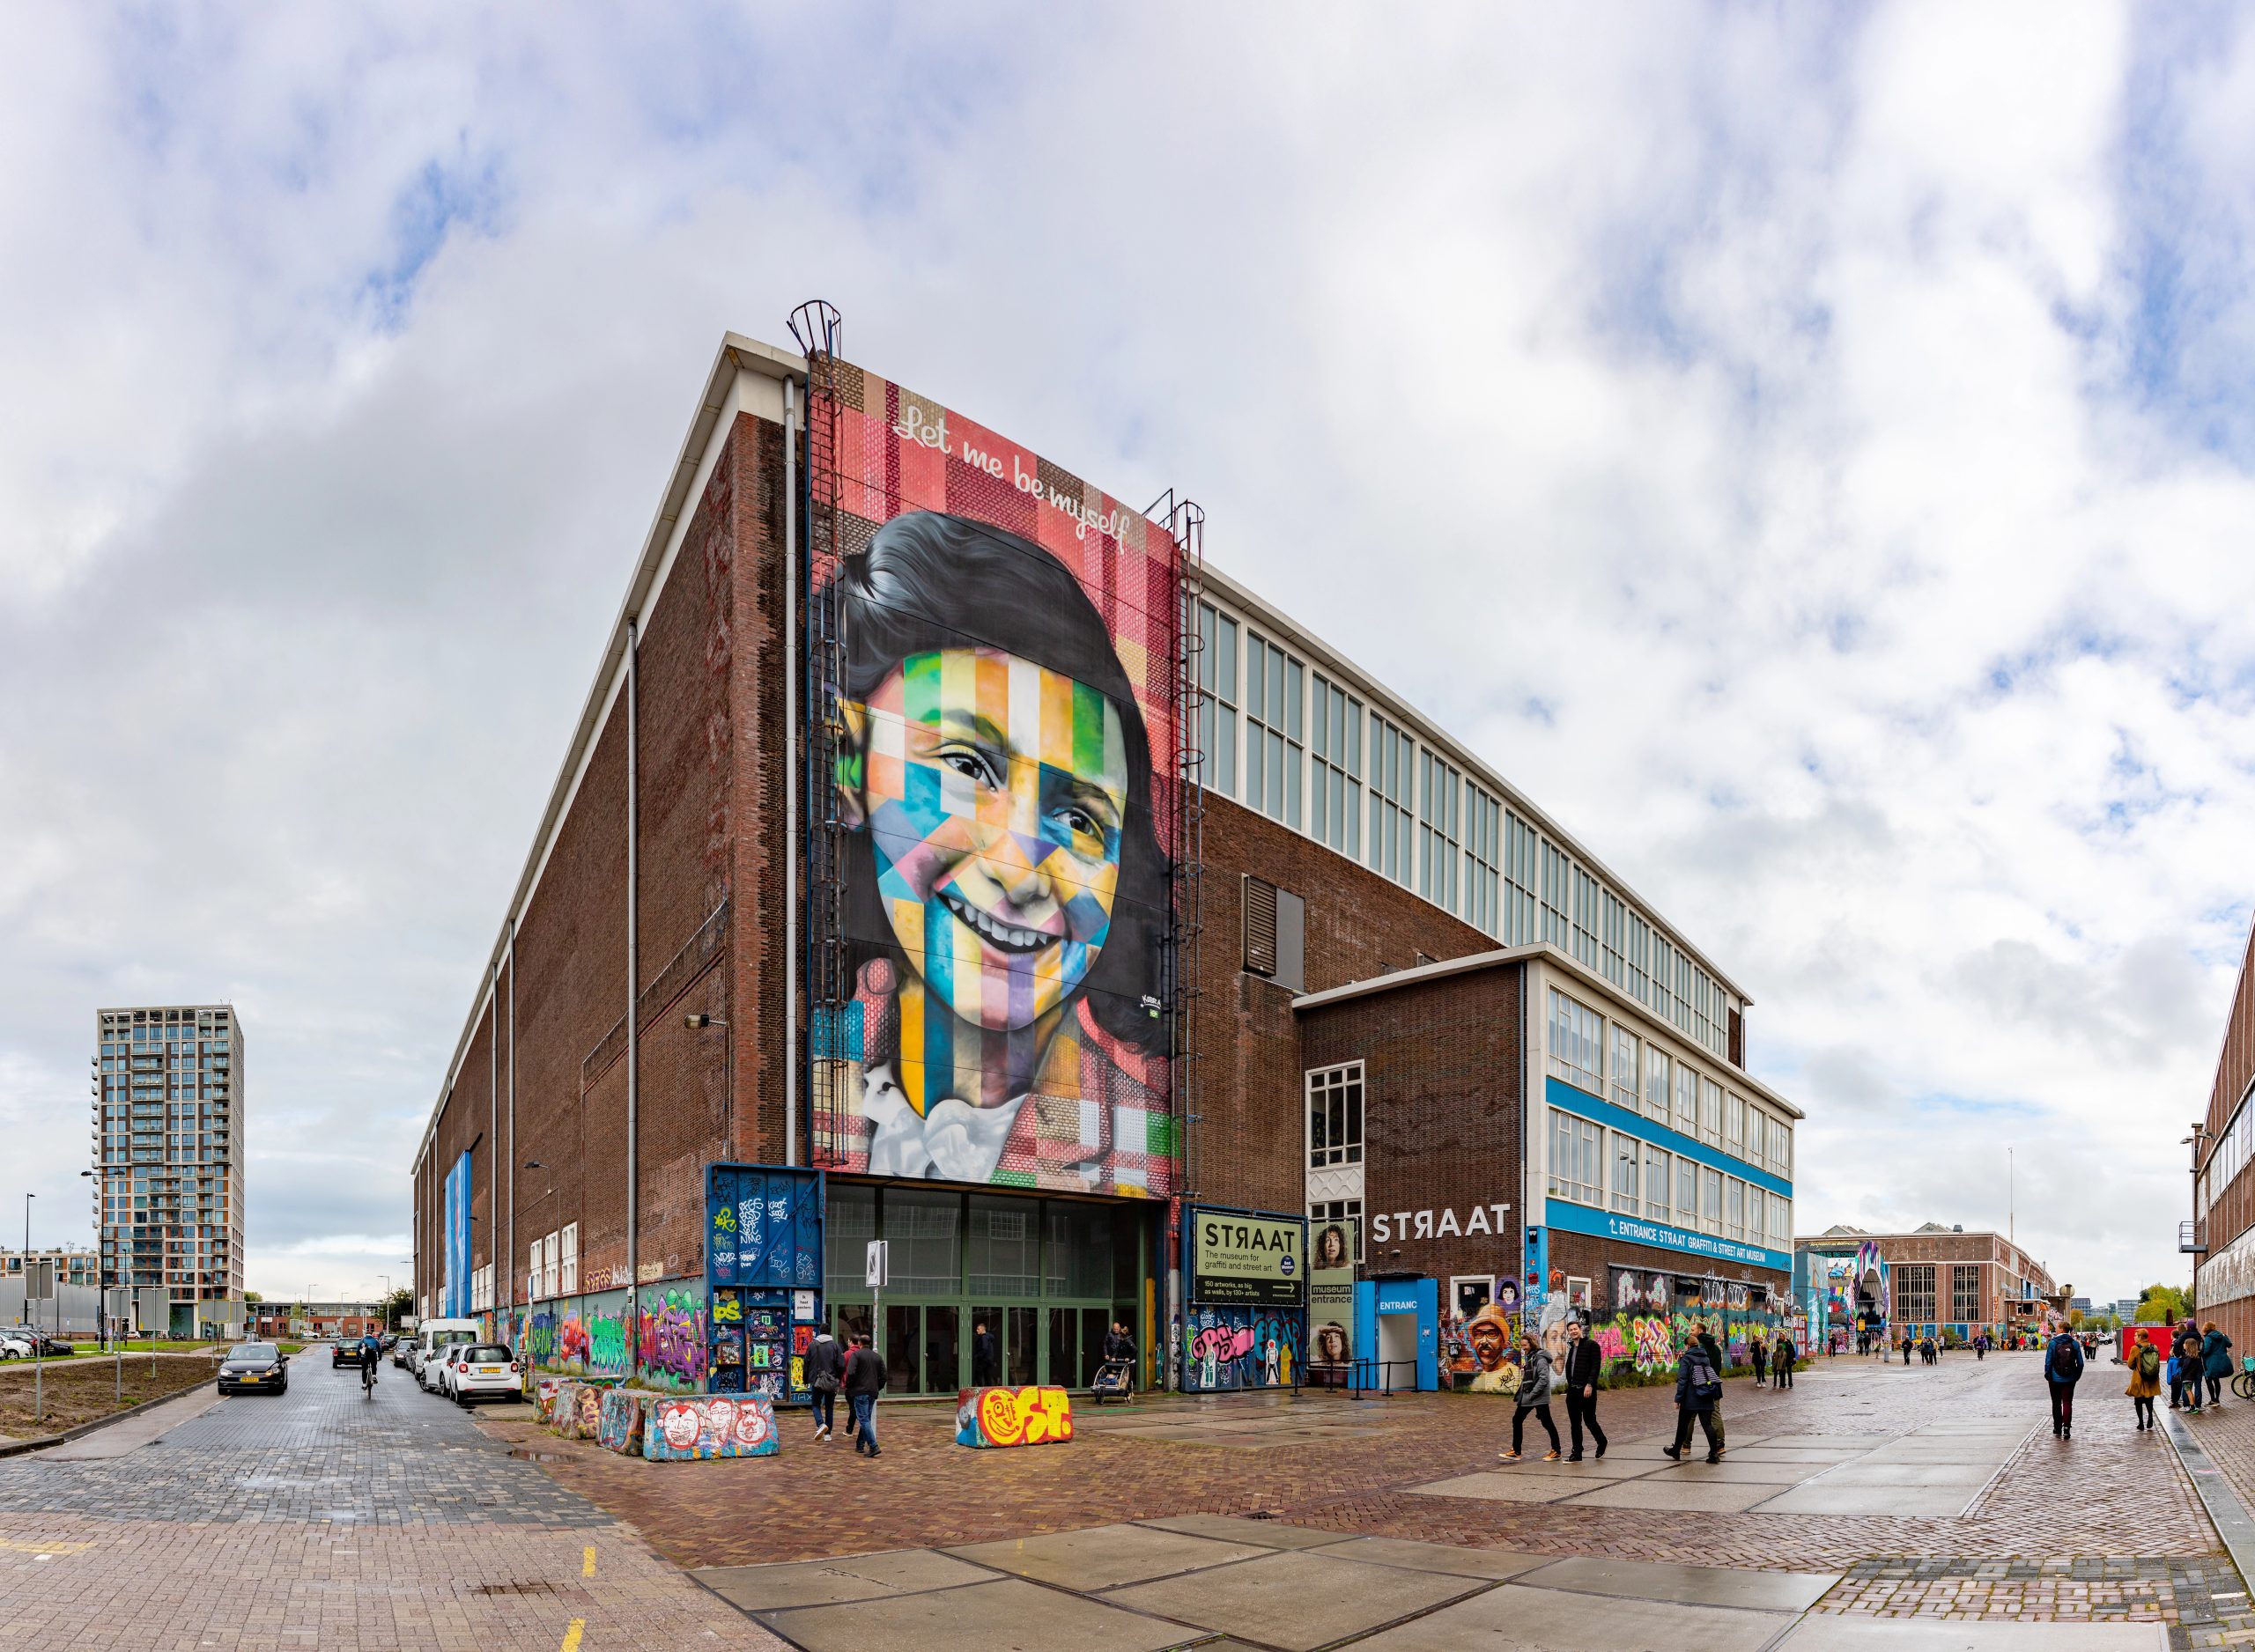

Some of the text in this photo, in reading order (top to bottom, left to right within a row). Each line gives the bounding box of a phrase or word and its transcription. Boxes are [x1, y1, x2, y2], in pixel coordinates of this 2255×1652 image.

[892, 406, 1130, 555] Let me be myself
[1205, 1223, 1295, 1252] STRAAT
[1372, 1203, 1511, 1243] STRAAT
[1619, 1221, 1766, 1263] ENTRANCE STRAAT GRAFFITI & STREET ART MUSEUM
[1205, 1261, 1227, 1270] graffiti
[1379, 1301, 1417, 1310] ENTRANC
